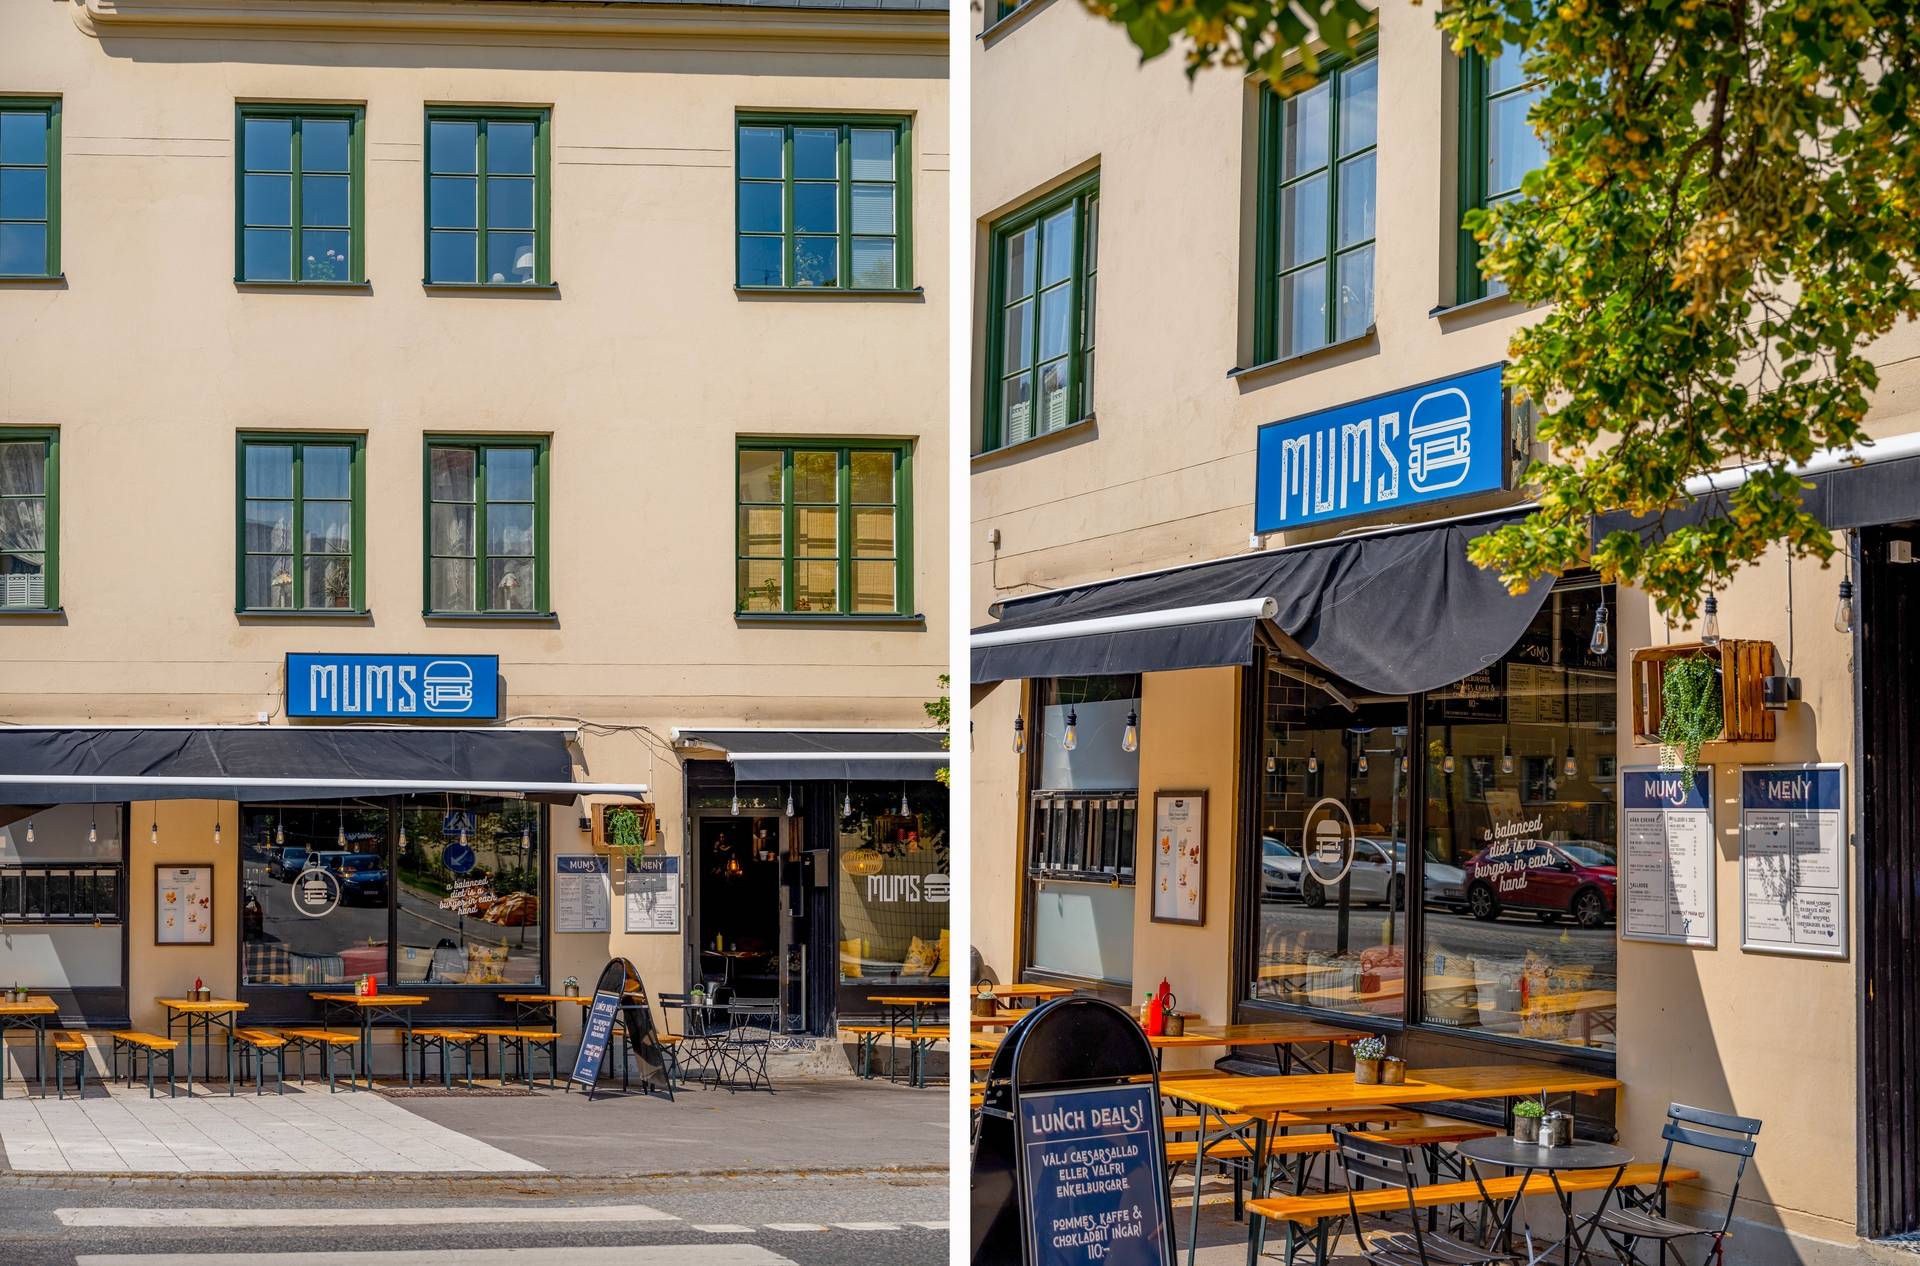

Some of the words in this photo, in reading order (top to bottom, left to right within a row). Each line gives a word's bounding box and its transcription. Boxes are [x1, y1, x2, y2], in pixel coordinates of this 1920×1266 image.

[1280, 411, 1400, 521] MUMS
[1526, 645, 1550, 663] UMS
[310, 664, 417, 712] MUMS
[1645, 780, 1685, 805] MUMS
[1768, 774, 1812, 799] MENY
[1484, 829, 1493, 841] a
[1495, 813, 1543, 839] balanced
[1489, 838, 1511, 858] diet
[1513, 837, 1525, 854] is
[1526, 838, 1536, 850] a
[569, 860, 595, 873] MUMS
[640, 859, 664, 870] MENY
[1474, 860, 1512, 882] burger
[1514, 855, 1527, 871] in
[1528, 848, 1555, 869] each
[454, 876, 489, 889] balanced
[867, 874, 920, 903] MUMS
[1499, 871, 1528, 893] hand
[1032, 1107, 1085, 1134] LUNCH
[1091, 1099, 1144, 1132] DEALS!
[1042, 1152, 1068, 1167] VÄLJ
[1070, 1145, 1139, 1166] CAESARSALLAD
[1060, 1167, 1089, 1181] ELLER
[1092, 1162, 1125, 1178] VALFRI
[1099, 1209, 1129, 1226] KAFFE
[1132, 1204, 1143, 1219] &
[1053, 1223, 1109, 1248] CHOKLADBIT
